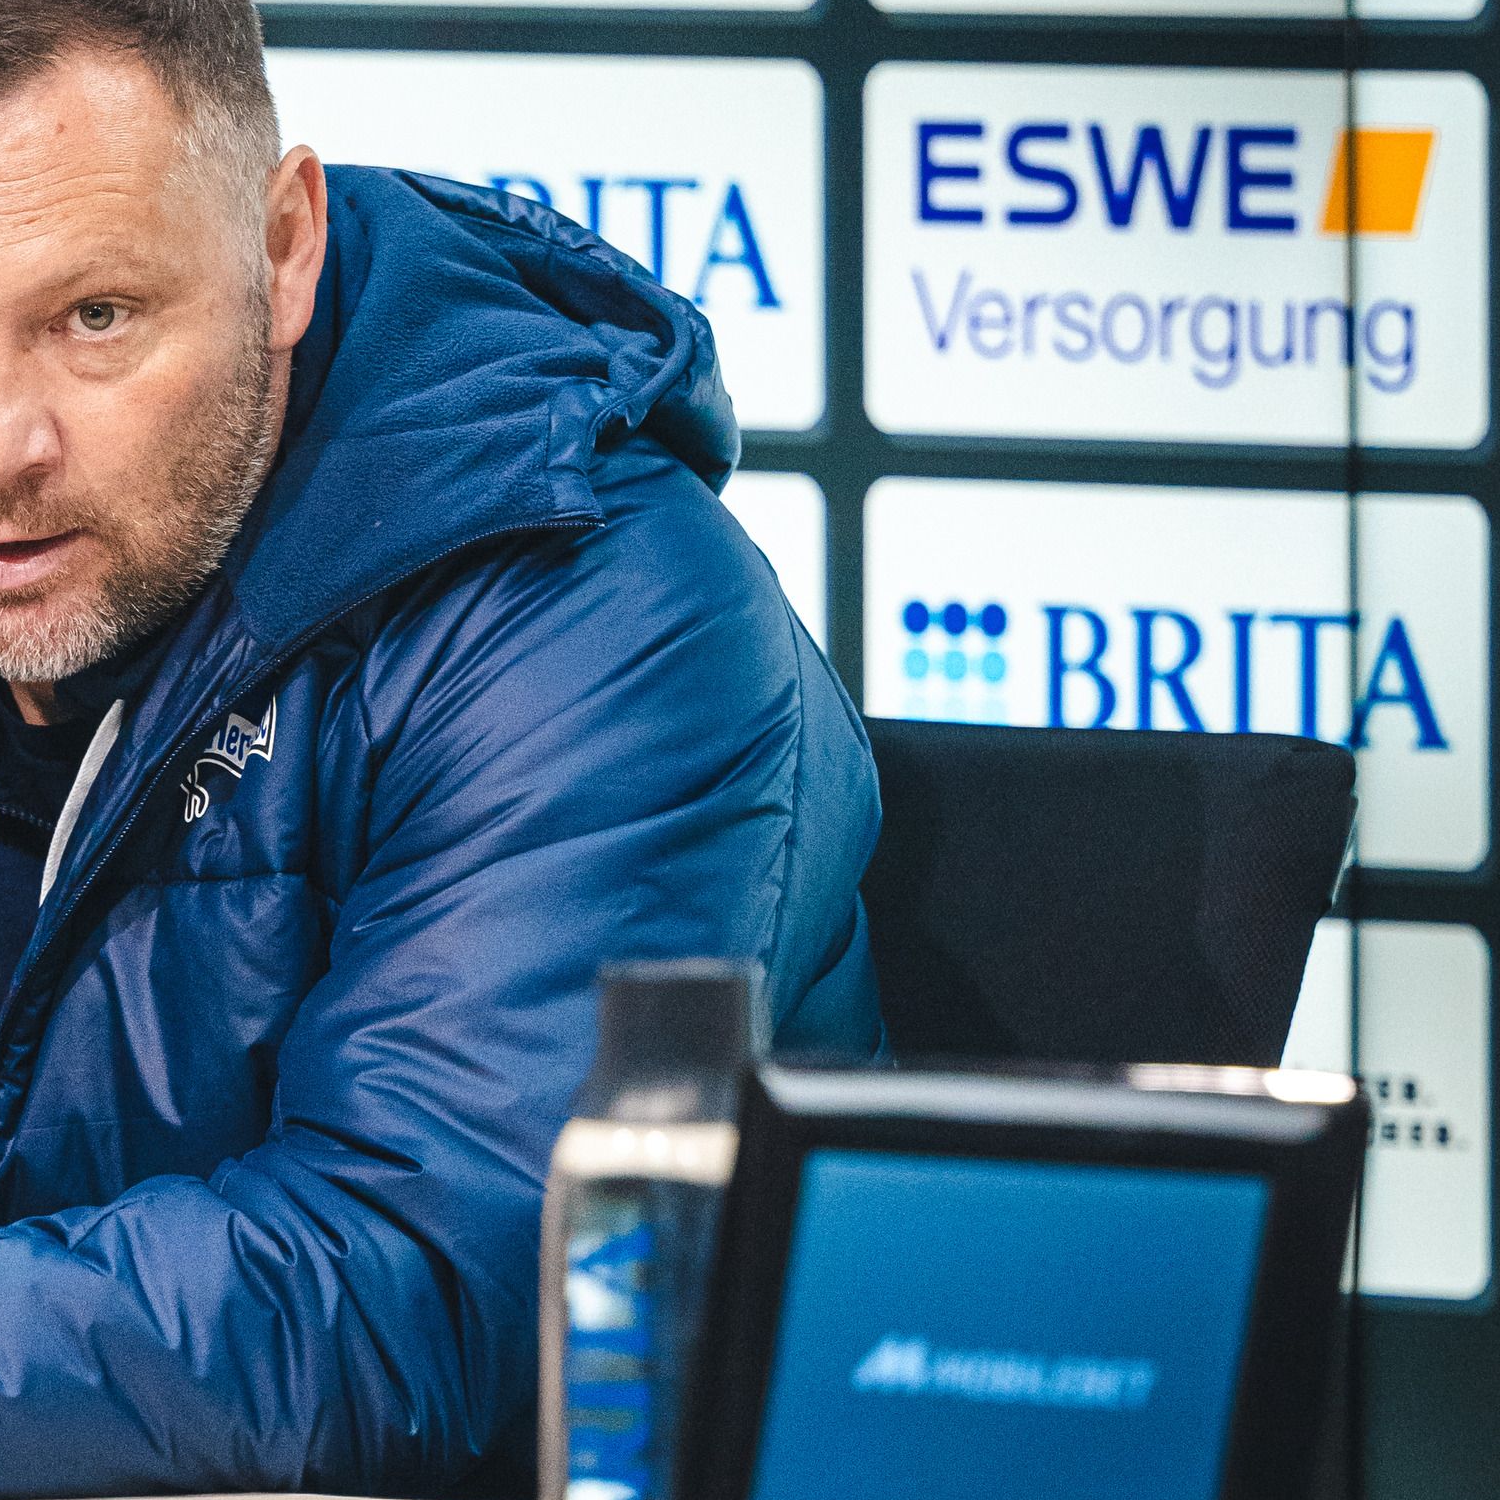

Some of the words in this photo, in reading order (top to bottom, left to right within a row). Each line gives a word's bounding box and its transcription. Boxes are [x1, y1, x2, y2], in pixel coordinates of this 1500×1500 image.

[915, 121, 1297, 233] ESWE
[911, 268, 1417, 393] Versorgung
[1040, 606, 1450, 751] BRITA
